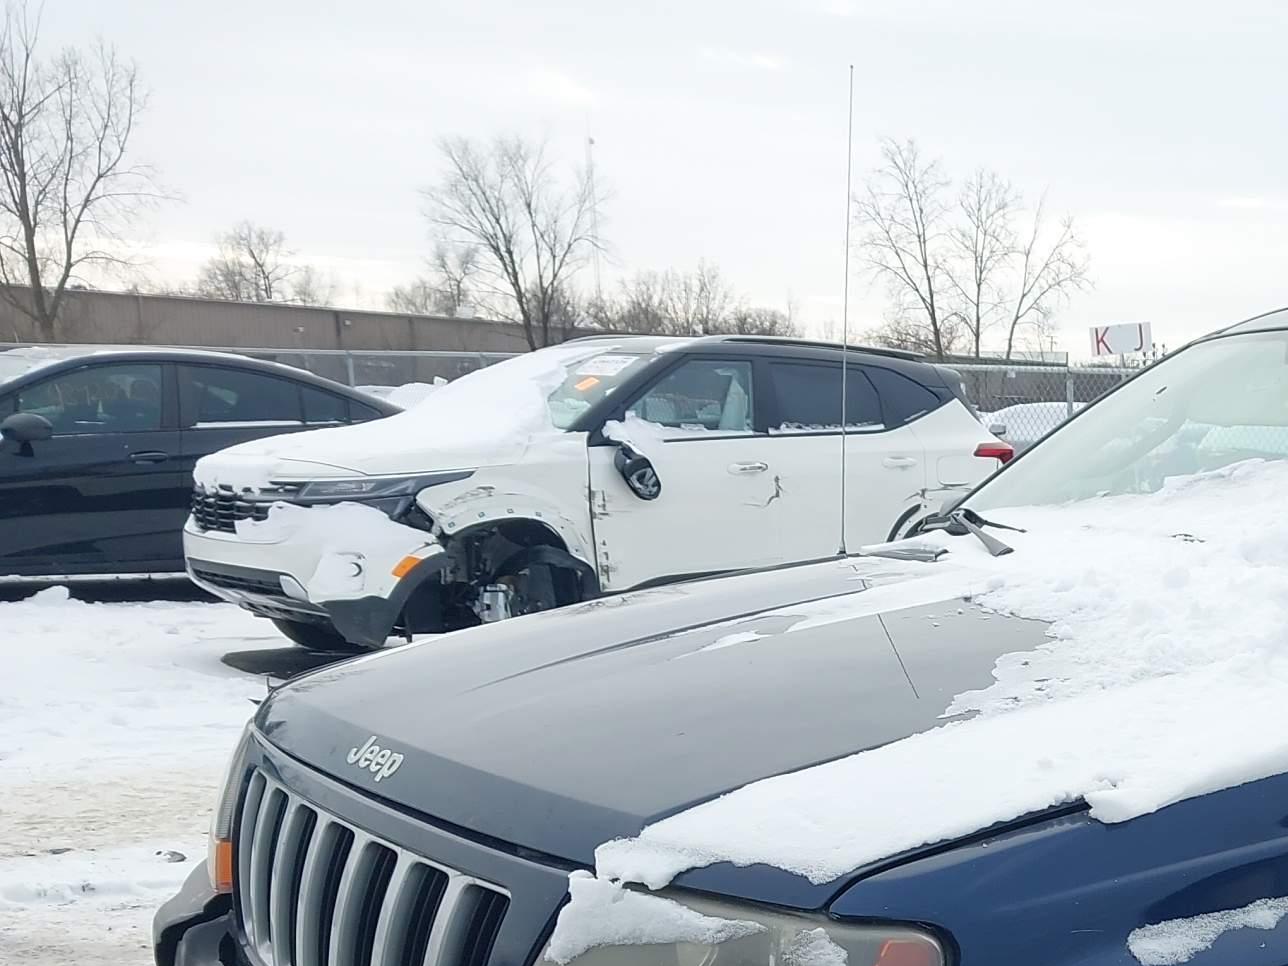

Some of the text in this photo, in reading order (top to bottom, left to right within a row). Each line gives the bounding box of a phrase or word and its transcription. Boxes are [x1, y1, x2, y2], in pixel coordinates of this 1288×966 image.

[1095, 322, 1144, 356] K J
[346, 735, 404, 782] Jeep
